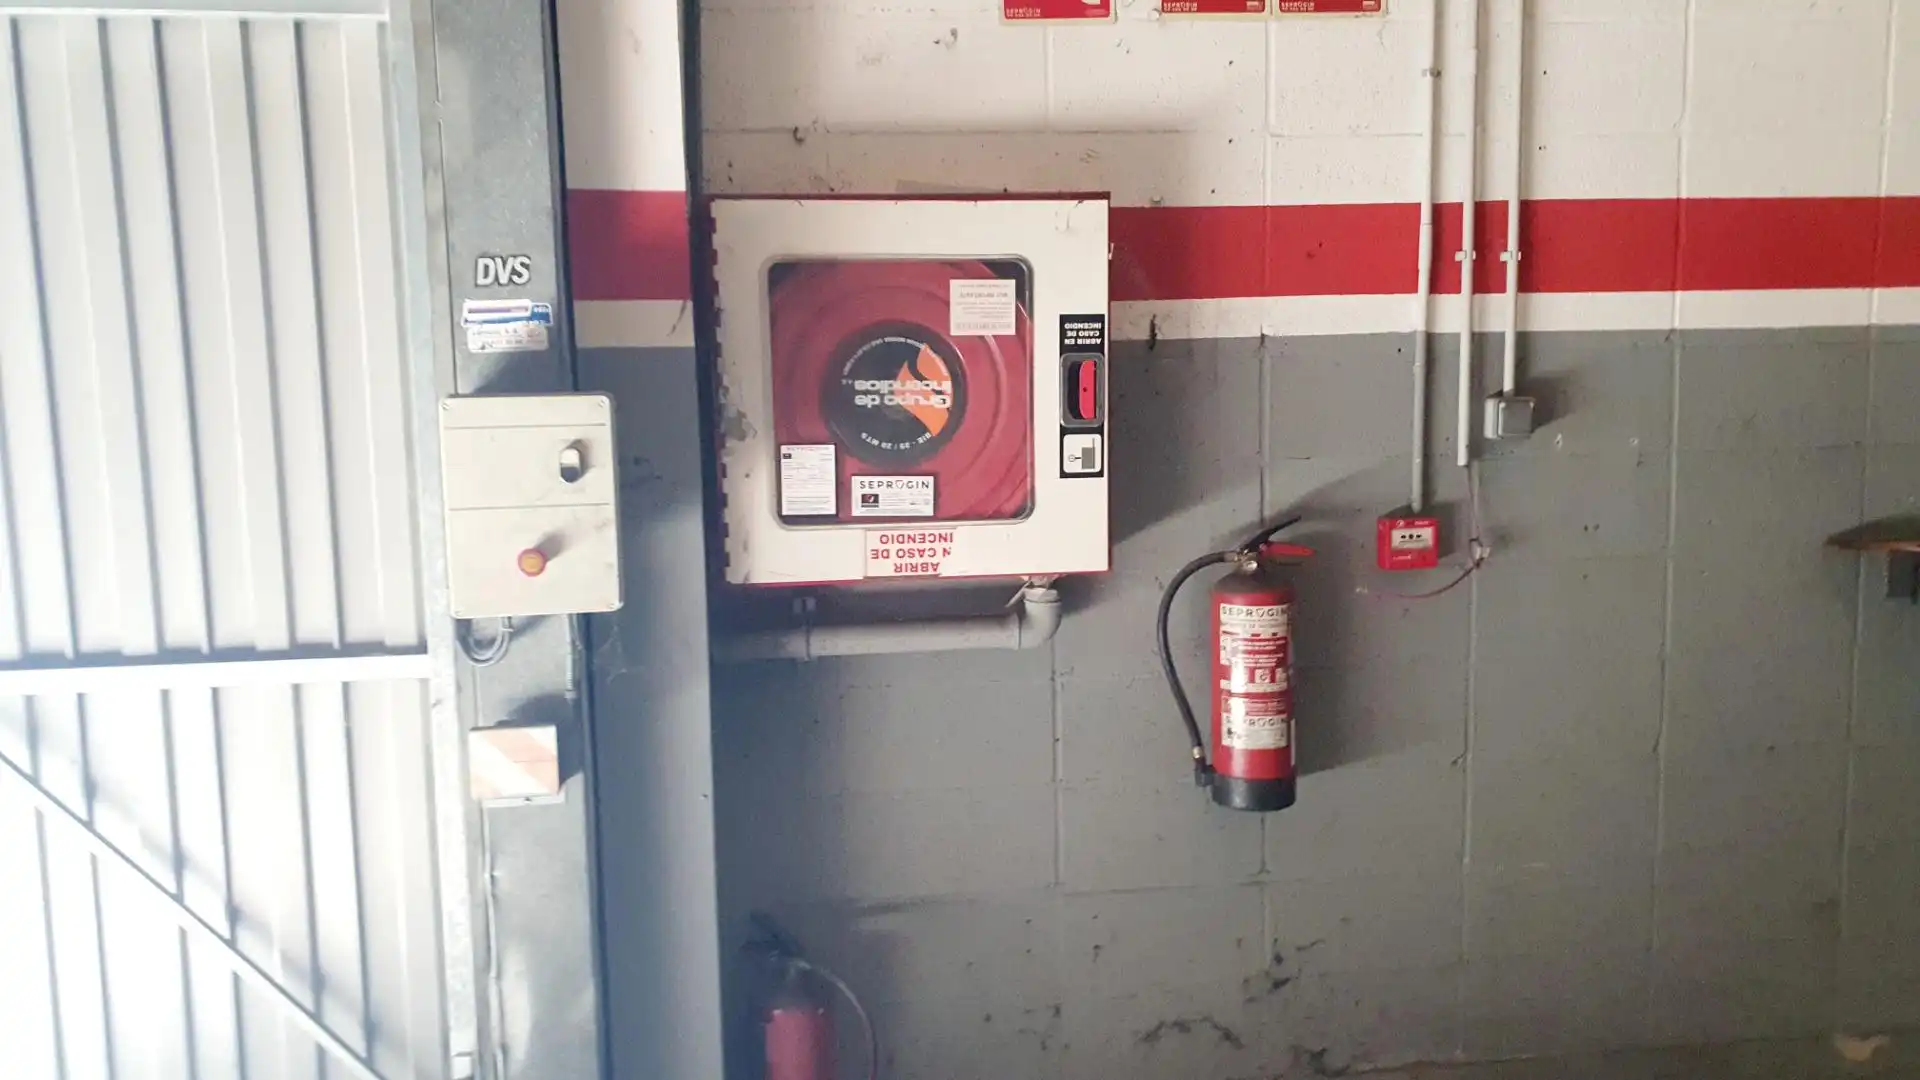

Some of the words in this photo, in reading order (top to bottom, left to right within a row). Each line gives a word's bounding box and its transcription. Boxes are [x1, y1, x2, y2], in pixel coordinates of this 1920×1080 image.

[475, 255, 532, 286] DVS
[854, 394, 881, 408] de
[884, 392, 952, 408] Grupo
[859, 480, 930, 490] SEPROGIN
[879, 532, 954, 545] INCENDIO
[870, 548, 890, 560] DE
[896, 547, 937, 559] CASO
[894, 562, 941, 573] ABRIR
